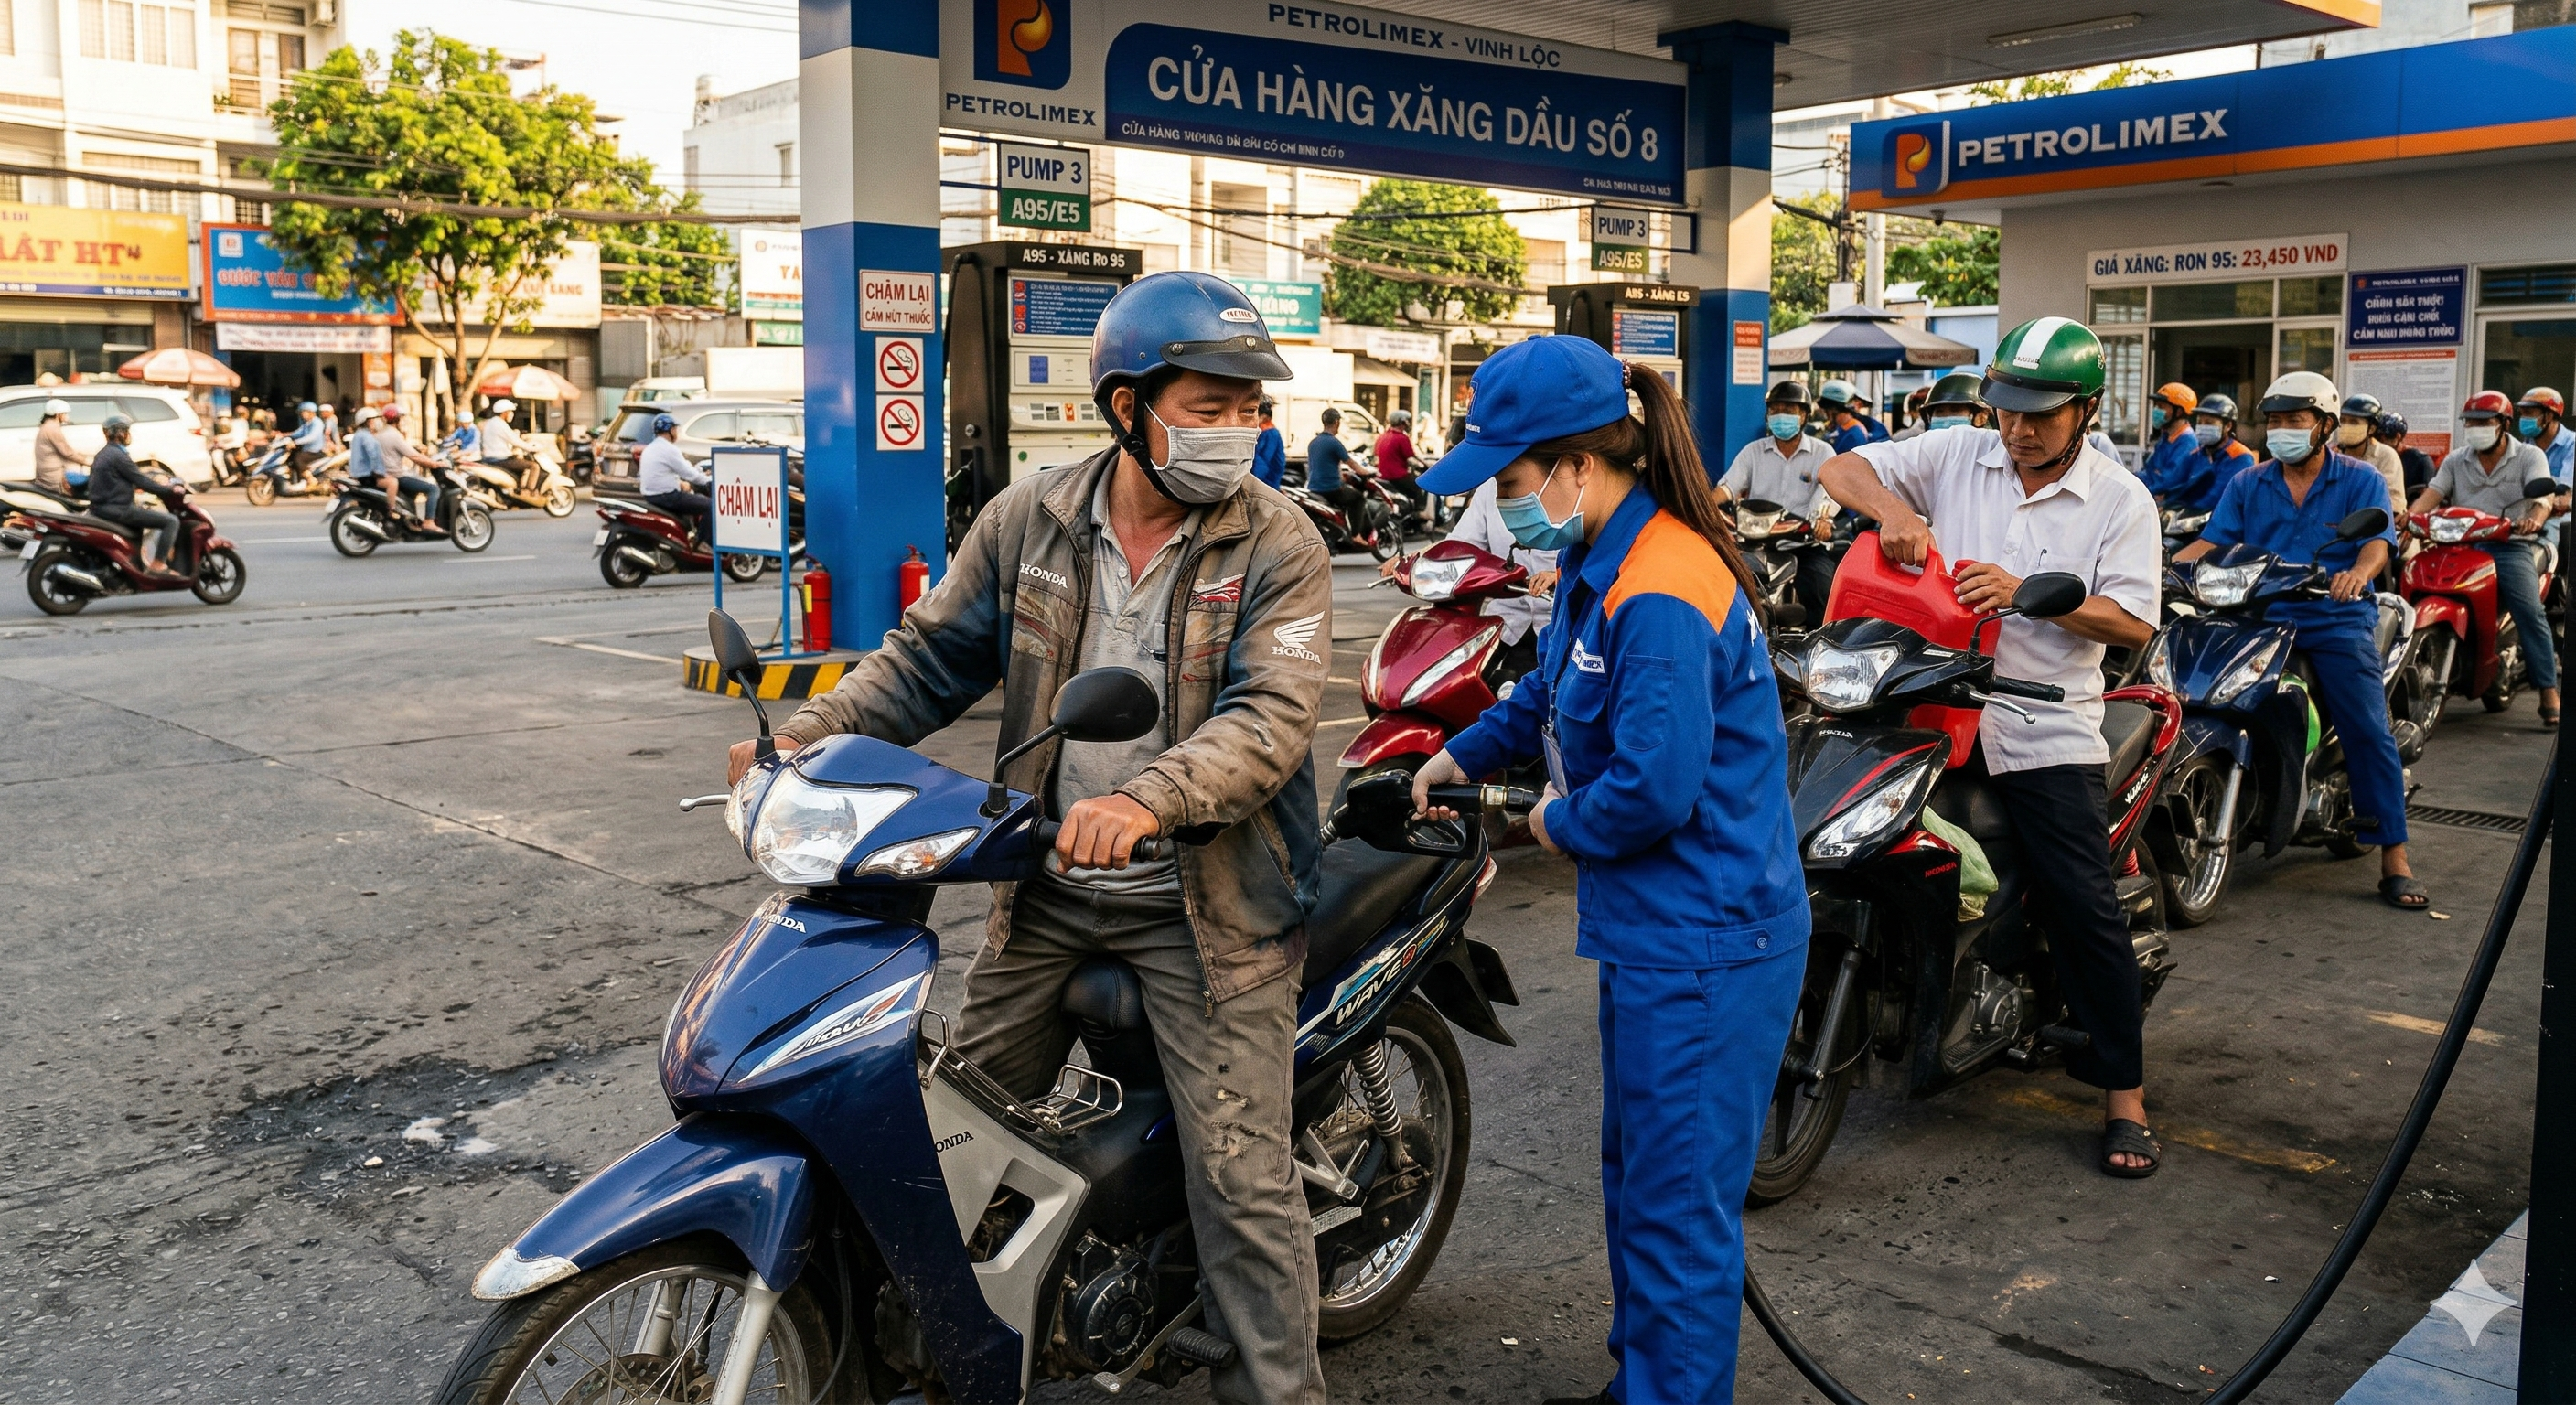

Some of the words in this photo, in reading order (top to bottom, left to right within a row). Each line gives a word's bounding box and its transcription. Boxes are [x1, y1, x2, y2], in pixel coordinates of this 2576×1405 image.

[1269, 4, 1443, 48] PETROLIMEX
[1465, 38, 1513, 59] VINH
[1519, 45, 1560, 70] LỘC
[946, 92, 1096, 126] PETROLIMEX
[1148, 44, 1242, 110] CỬA
[1257, 64, 1374, 126] HÀNG
[1387, 83, 1493, 142] XĂNG
[1506, 95, 1576, 152] DẦU
[1587, 109, 1633, 159] SỐ
[1641, 127, 1658, 162] 8
[1149, 124, 1180, 140] HÀNG
[1959, 108, 2228, 167] PETROLIMEX
[1007, 156, 1065, 182] PUMP
[1070, 161, 1082, 184] 3
[1011, 198, 1080, 224] A95/E5
[1598, 216, 1635, 237] PUMP
[1637, 219, 1646, 238] 3
[1110, 253, 1125, 268] 95
[2095, 253, 2119, 275] GIÁ
[2174, 252, 2206, 271] RON
[2212, 251, 2237, 269] 95:
[2241, 246, 2299, 269] 23,450
[2304, 243, 2338, 263] VND
[909, 284, 929, 305] LẠI
[758, 486, 778, 528] LẠI
[1019, 563, 1068, 589] HONDA
[1271, 646, 1322, 665] HONDA
[1336, 957, 1403, 1025] WAVE
[935, 1131, 975, 1153] ONDA
